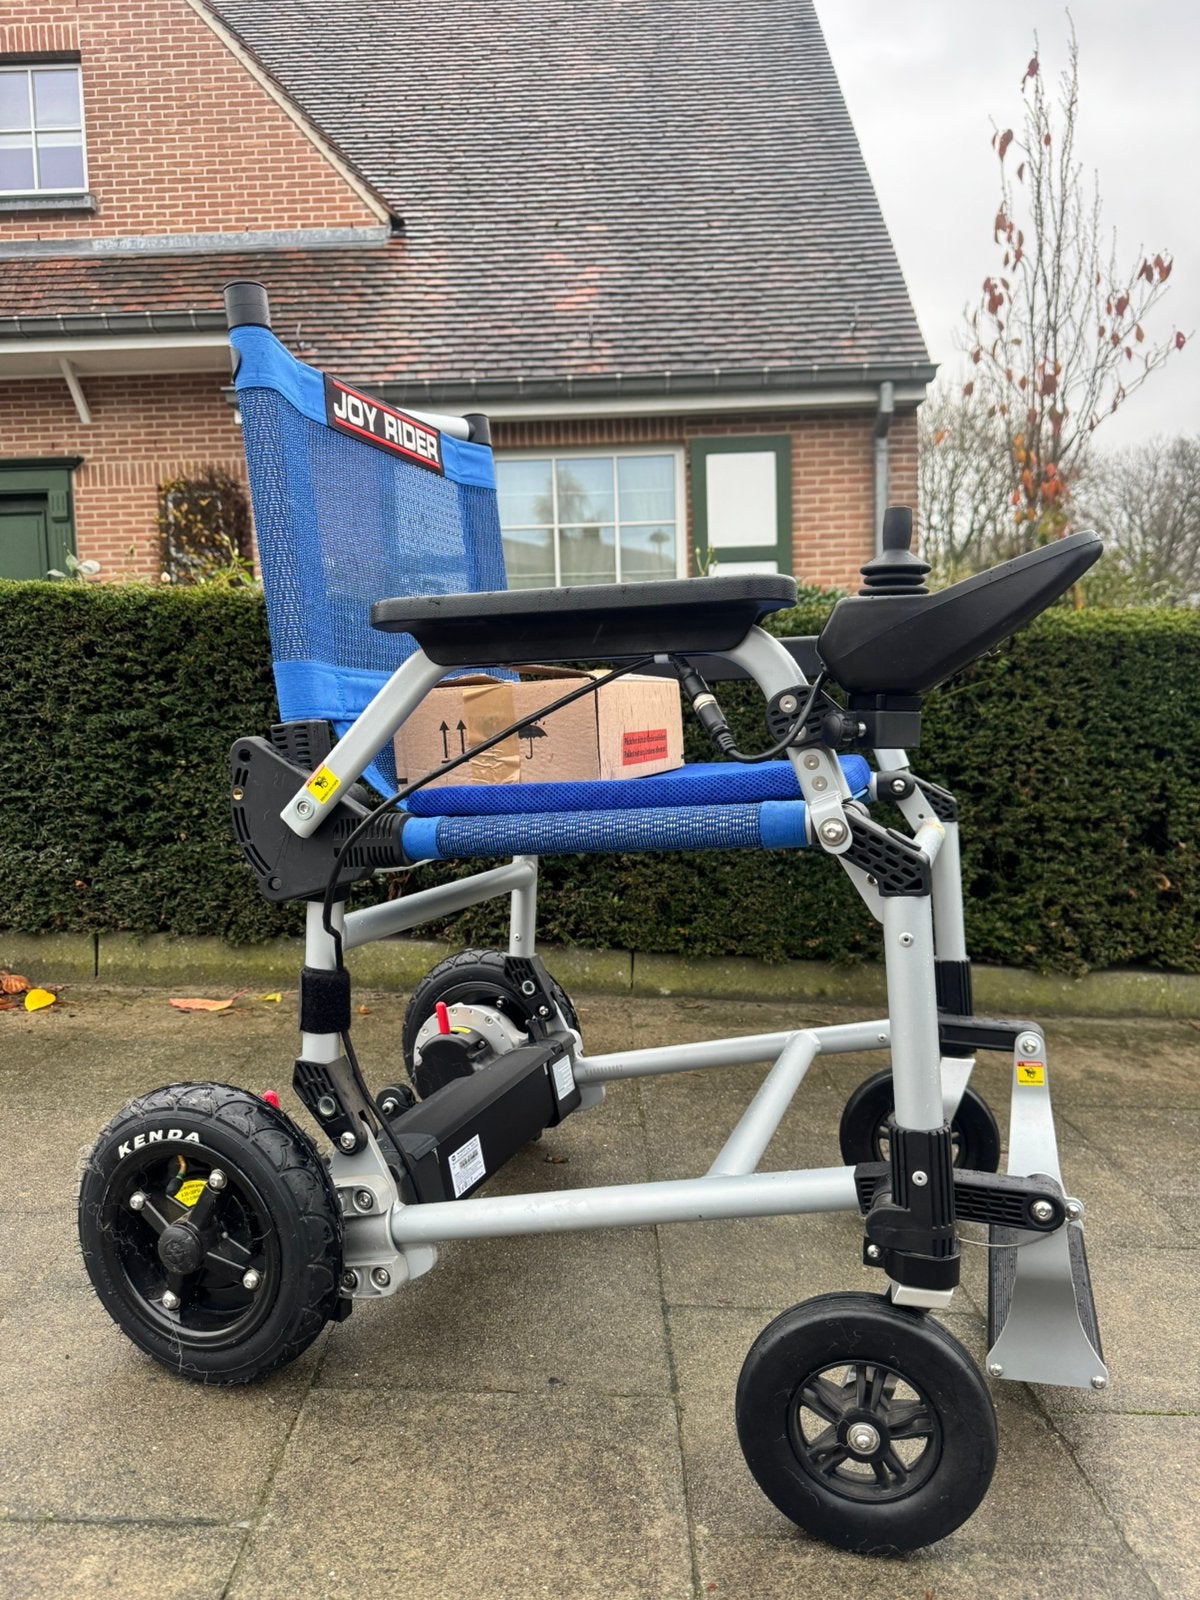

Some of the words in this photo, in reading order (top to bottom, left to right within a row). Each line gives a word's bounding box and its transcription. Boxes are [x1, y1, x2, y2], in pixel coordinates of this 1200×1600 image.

[333, 391, 378, 433] JOY
[383, 411, 440, 463] RIDER
[118, 1129, 201, 1160] KENDA
